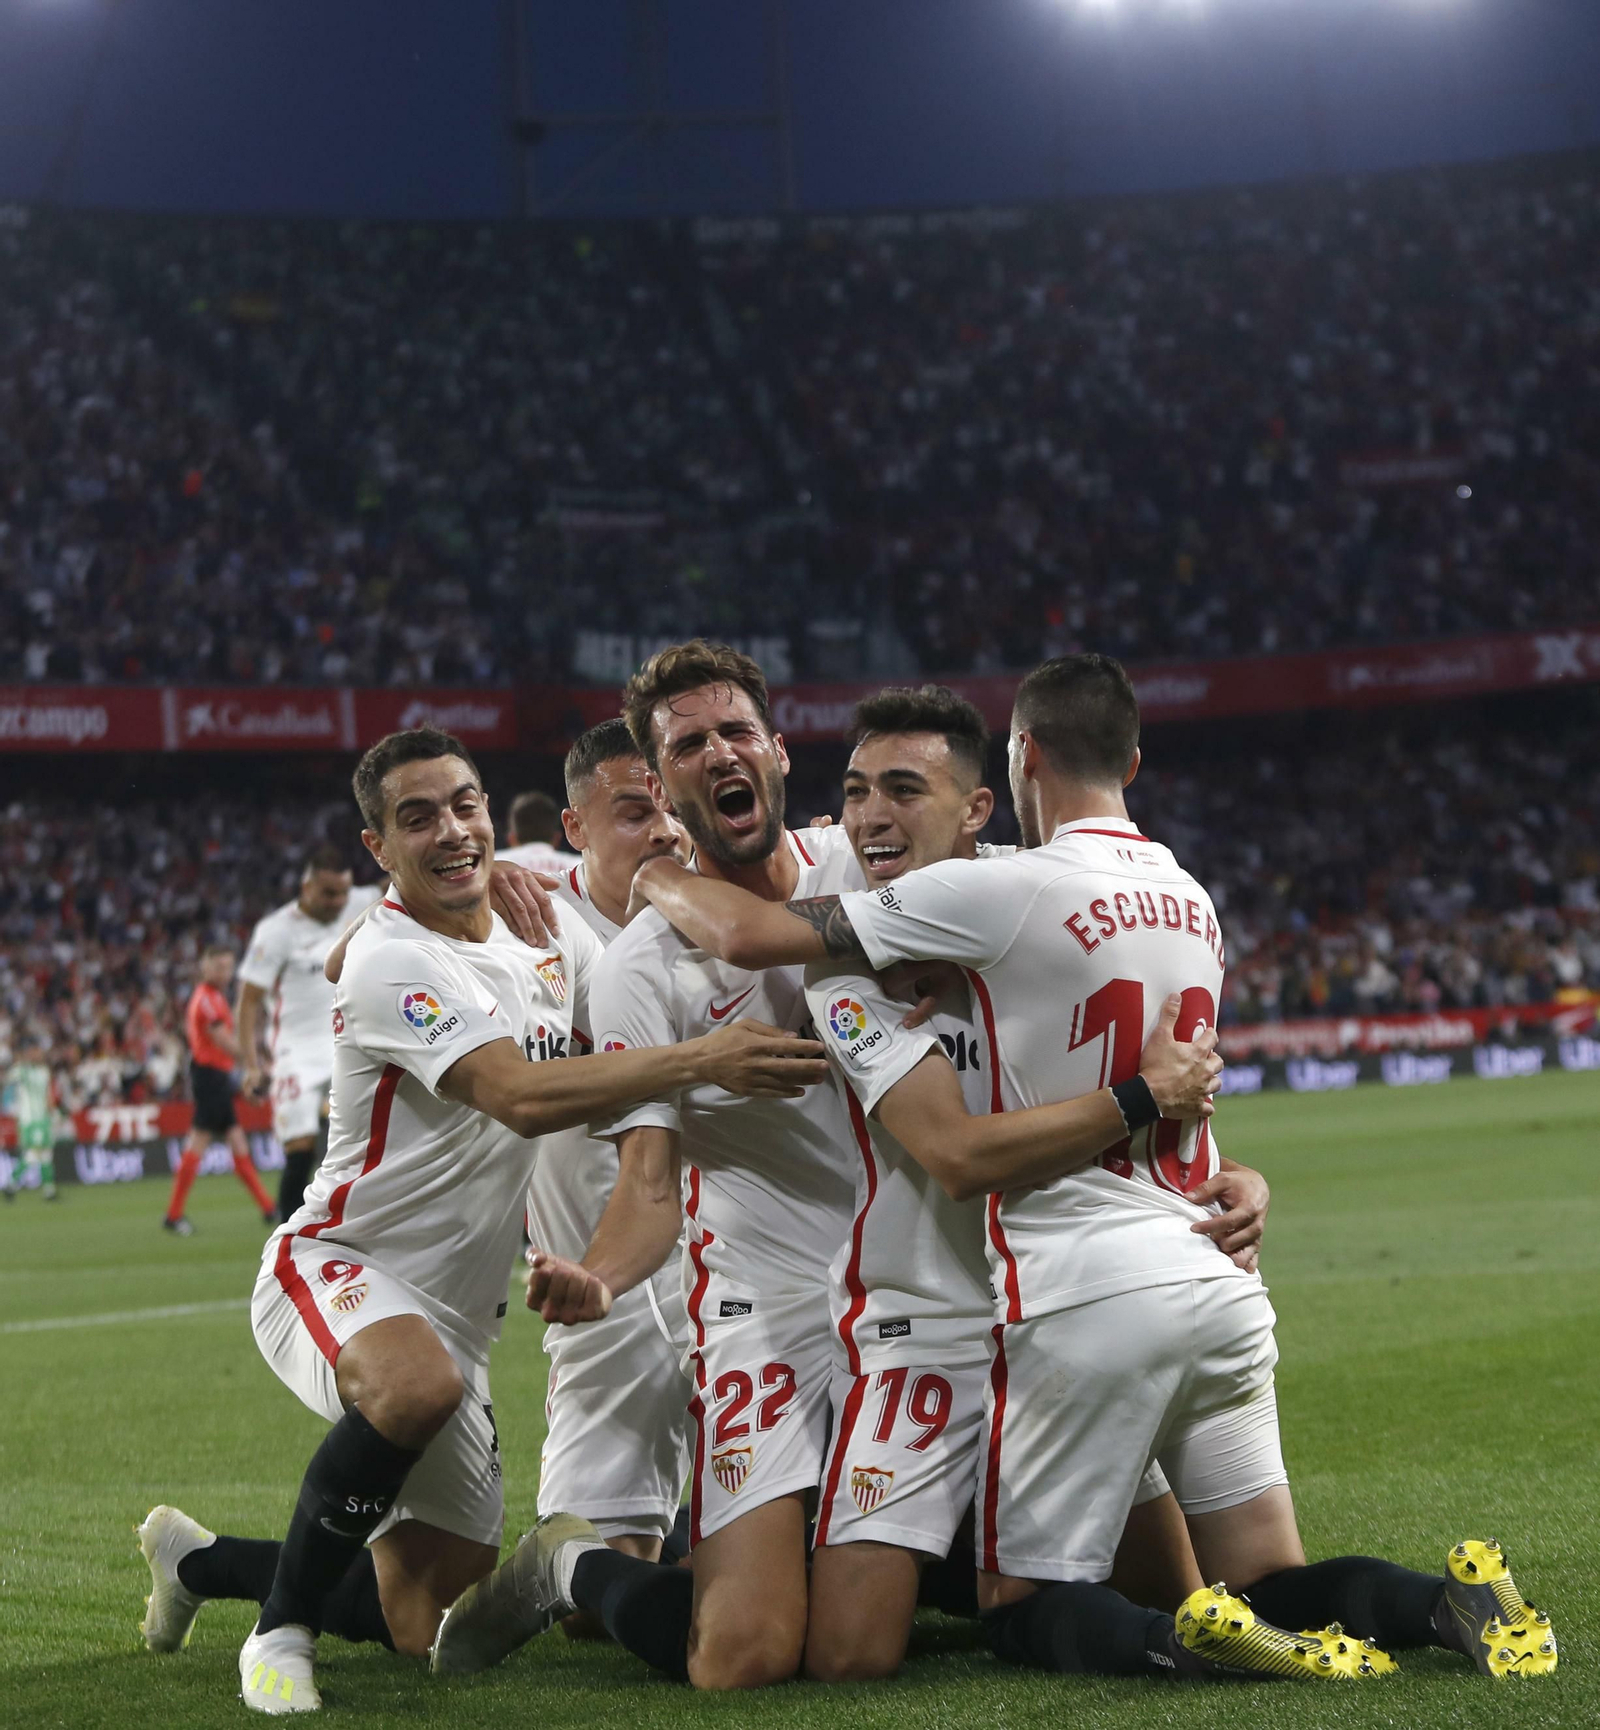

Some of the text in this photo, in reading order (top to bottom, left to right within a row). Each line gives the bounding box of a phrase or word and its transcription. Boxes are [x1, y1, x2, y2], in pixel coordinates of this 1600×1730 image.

[425, 1016, 458, 1046] LaLiga
[847, 1030, 883, 1060] LaLiga
[712, 1362, 797, 1449] 22
[872, 1367, 953, 1453] 19
[345, 1496, 386, 1514] SFC
